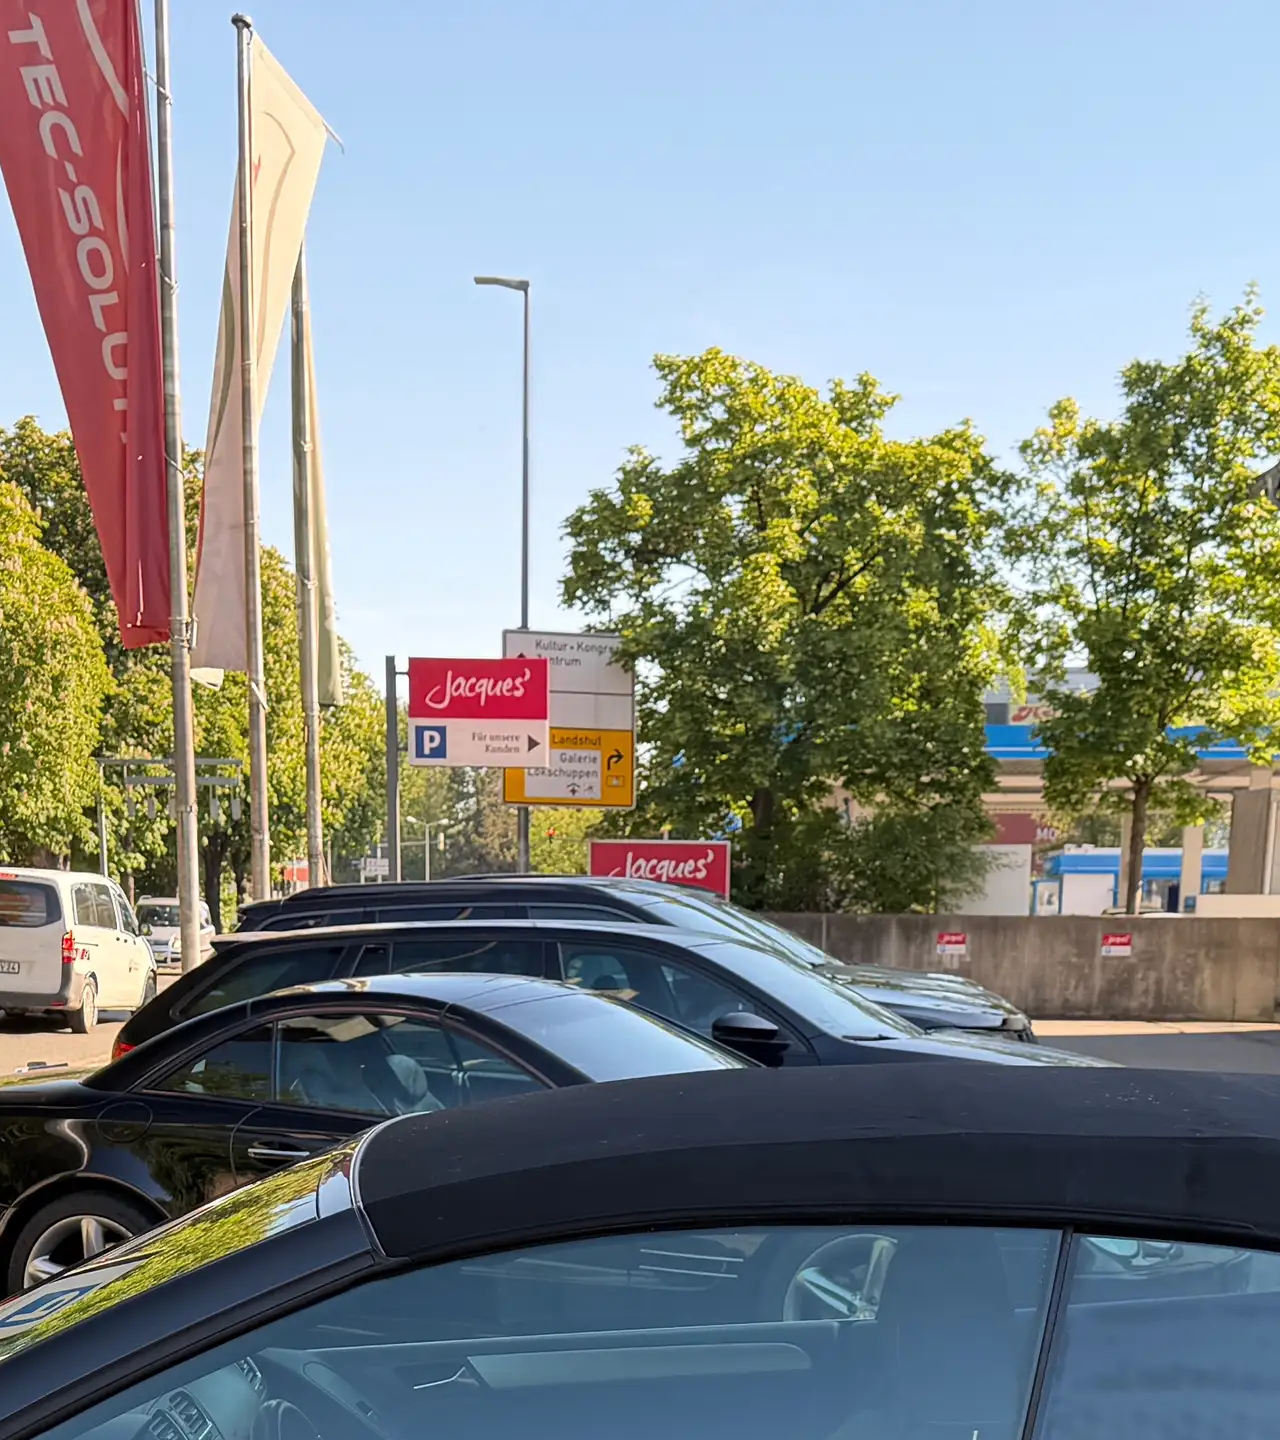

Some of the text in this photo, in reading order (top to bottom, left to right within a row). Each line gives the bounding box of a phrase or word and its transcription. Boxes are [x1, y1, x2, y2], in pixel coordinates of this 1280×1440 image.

[472, 731, 521, 742] Für unsere
[423, 730, 441, 755] P
[484, 744, 521, 753] Kunden
[560, 752, 598, 764] Galerie
